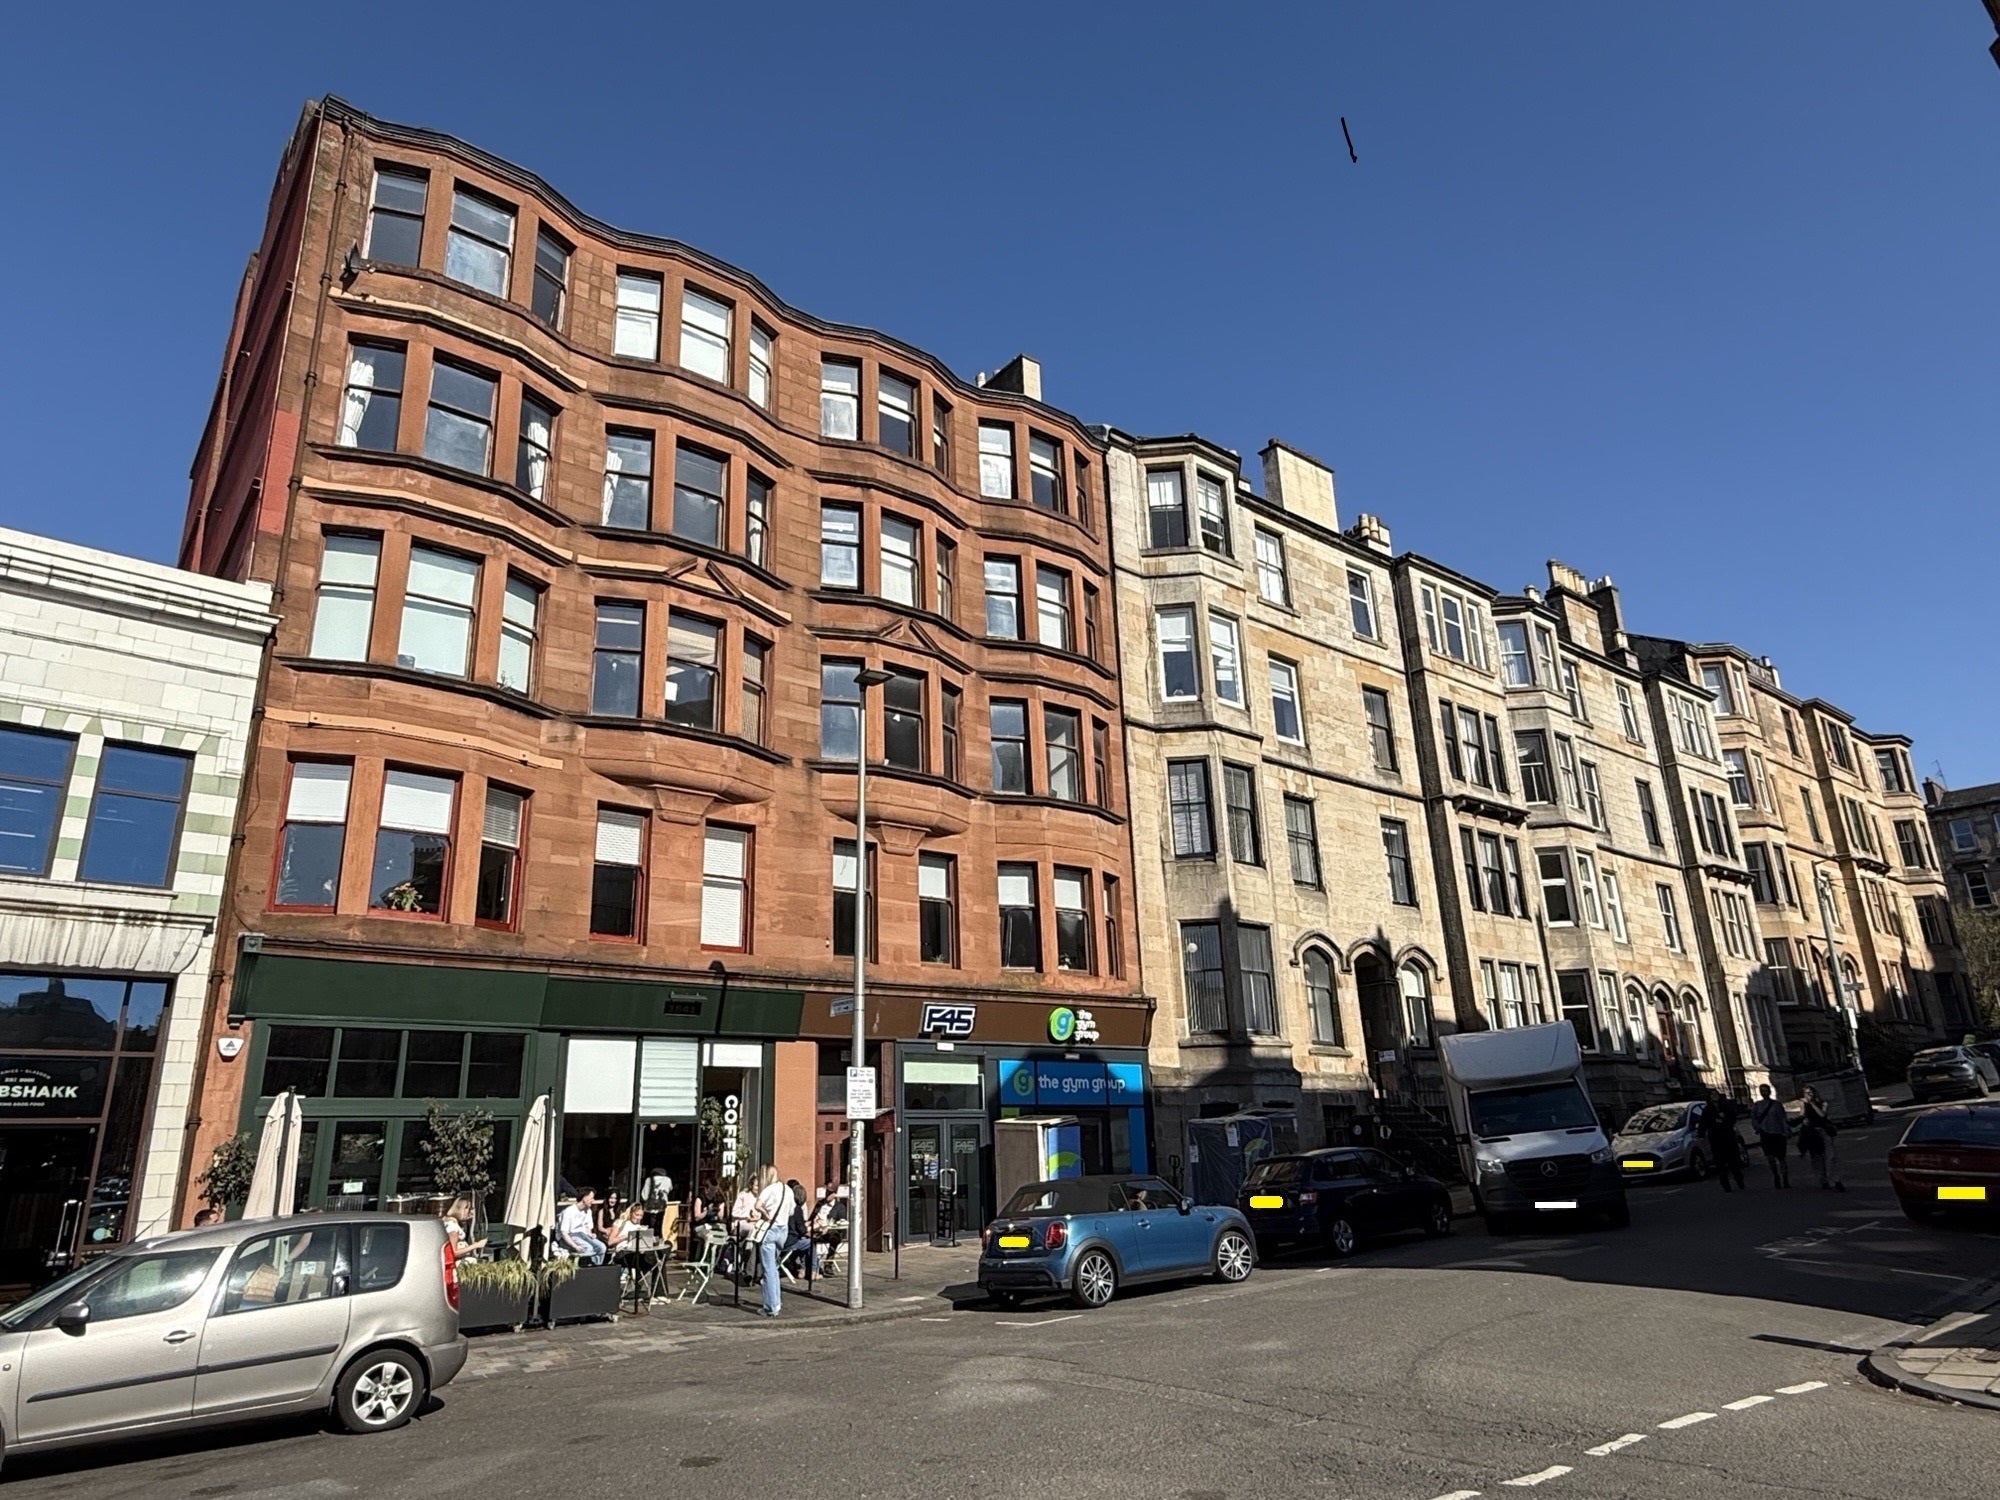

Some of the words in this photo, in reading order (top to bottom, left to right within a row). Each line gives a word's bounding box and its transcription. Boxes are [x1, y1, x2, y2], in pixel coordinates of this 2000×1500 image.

[923, 1005, 976, 1034] F45
[1077, 1009, 1093, 1020] the
[1075, 1020, 1096, 1031] gym
[1074, 1030, 1100, 1042] group
[1038, 1074, 1059, 1089] the
[1062, 1078, 1090, 1093] gym
[0, 1085, 79, 1098] BSHAKK
[722, 1094, 739, 1178] COFFEE
[952, 1138, 977, 1154] F45
